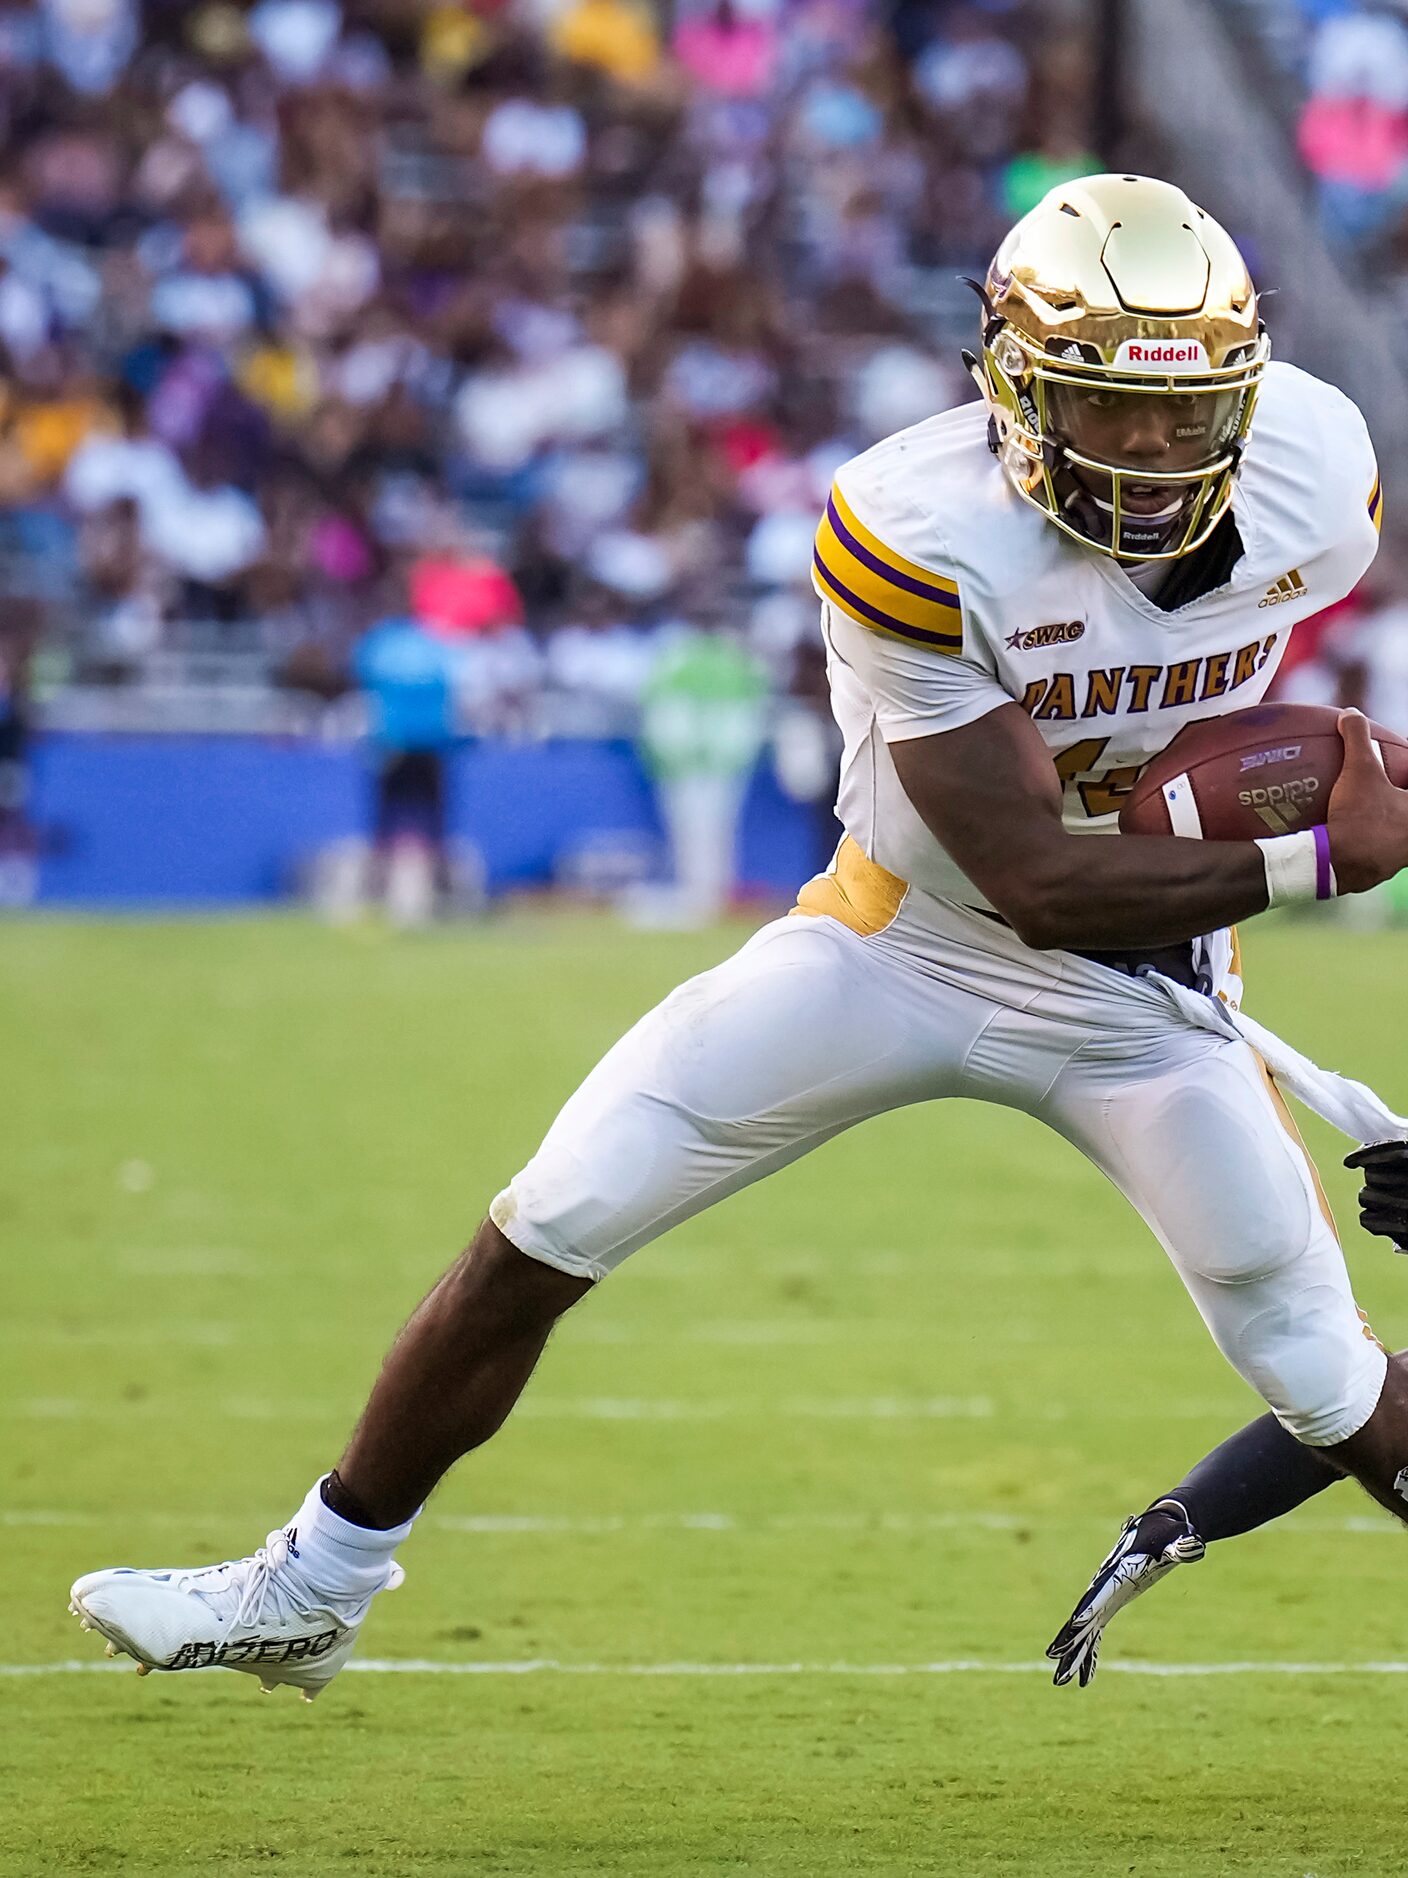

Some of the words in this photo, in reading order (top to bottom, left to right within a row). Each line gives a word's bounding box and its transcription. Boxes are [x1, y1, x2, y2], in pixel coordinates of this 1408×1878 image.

[1128, 345, 1198, 362] Riddell
[1123, 531, 1160, 541] Riddell
[1257, 587, 1308, 609] adidas
[1238, 776, 1319, 806] adidas
